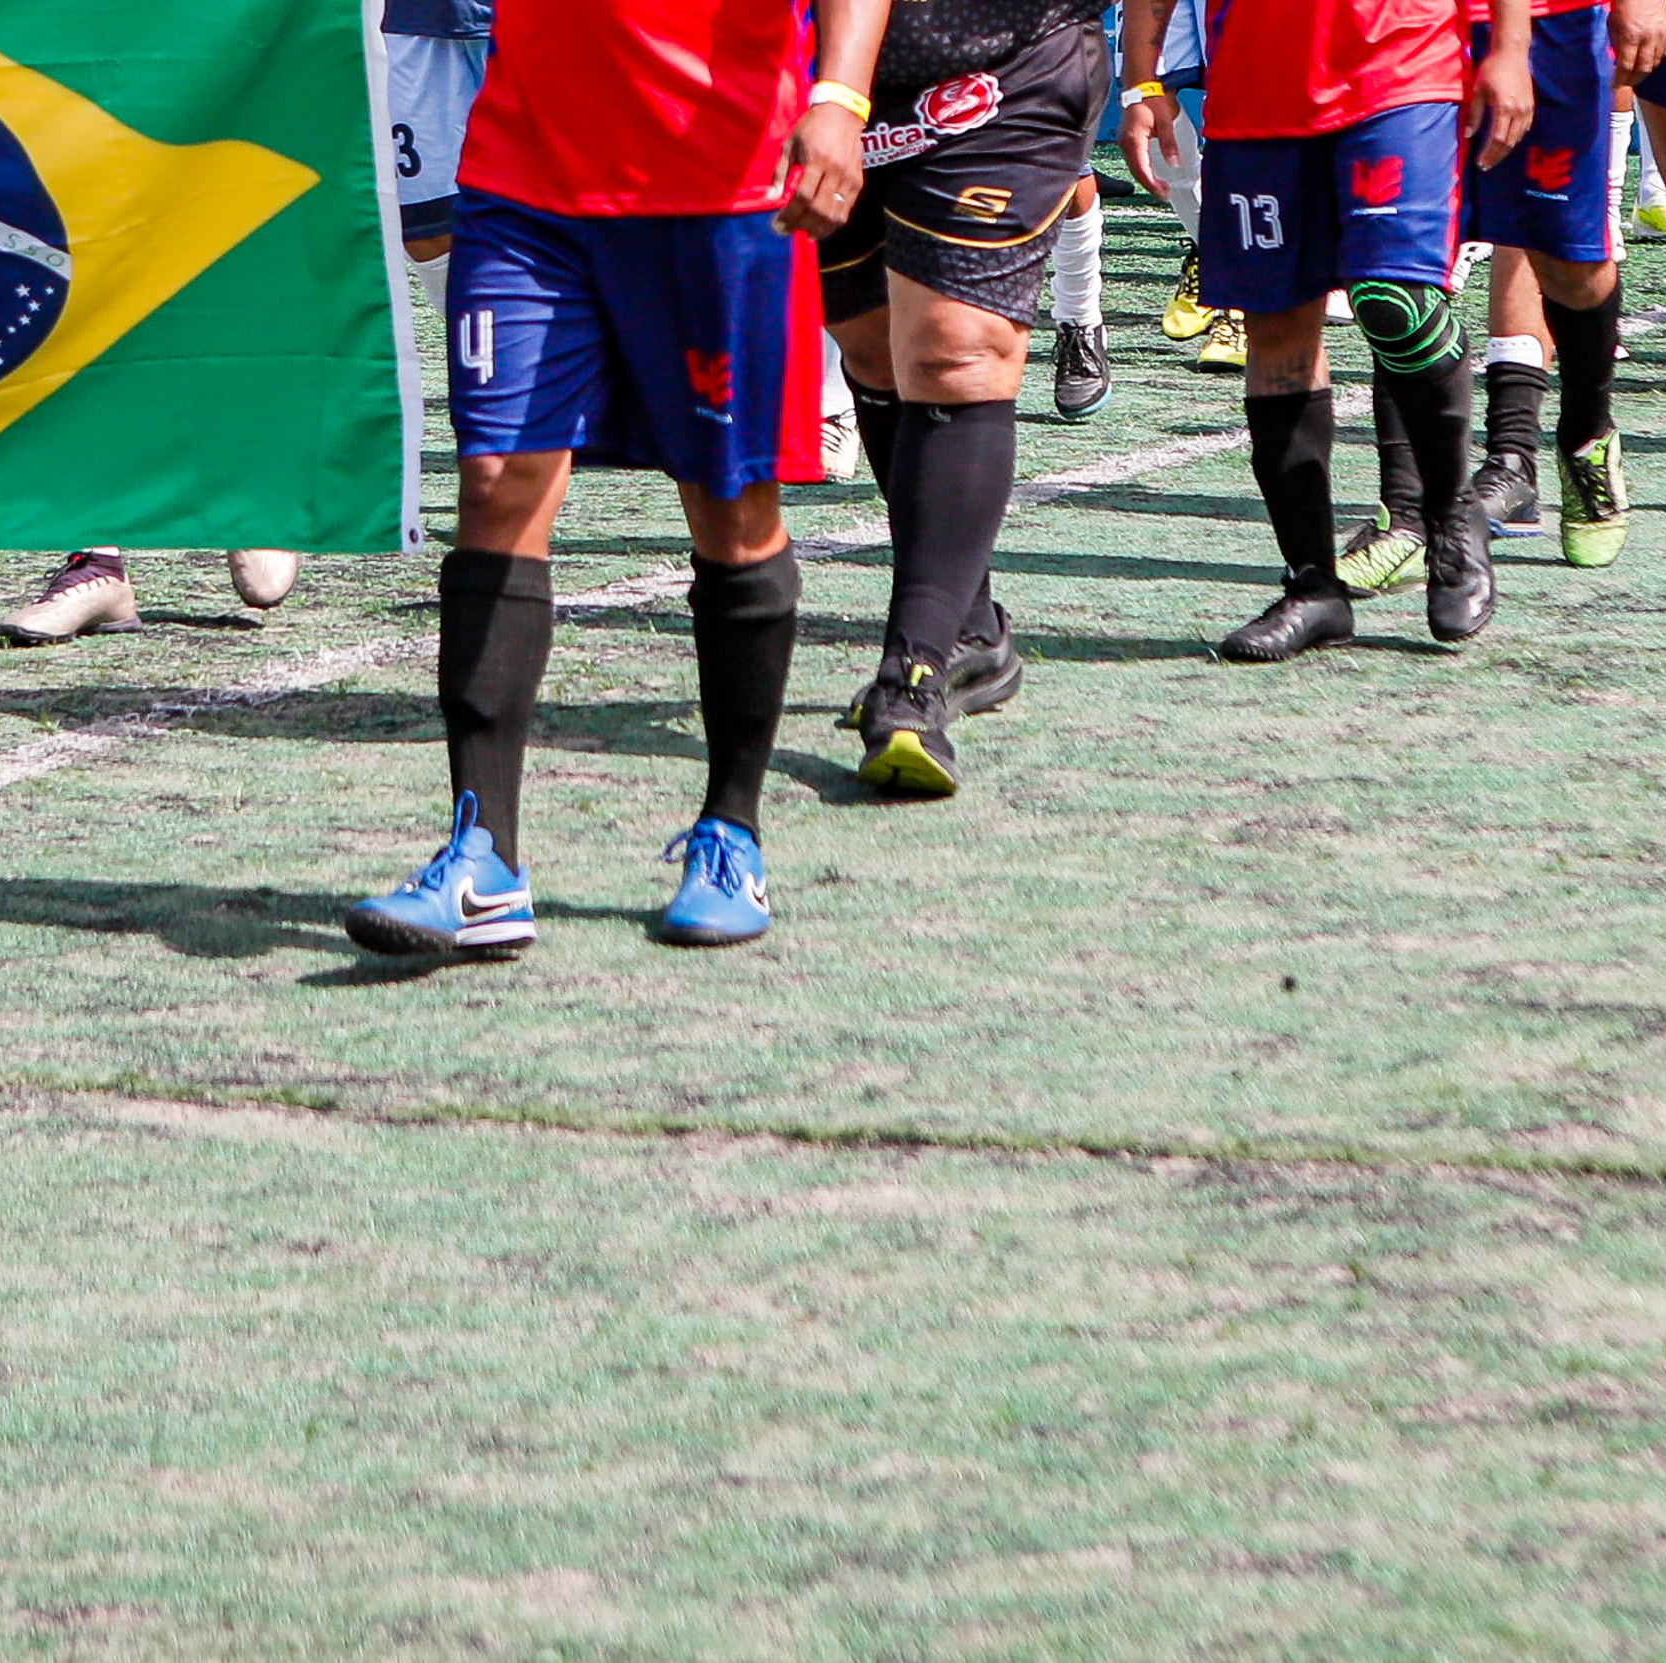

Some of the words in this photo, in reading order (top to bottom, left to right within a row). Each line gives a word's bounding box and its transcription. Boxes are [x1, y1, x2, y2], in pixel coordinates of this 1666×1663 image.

[861, 125, 923, 154] mica
[1230, 193, 1284, 250] 13
[460, 310, 493, 386] 4
